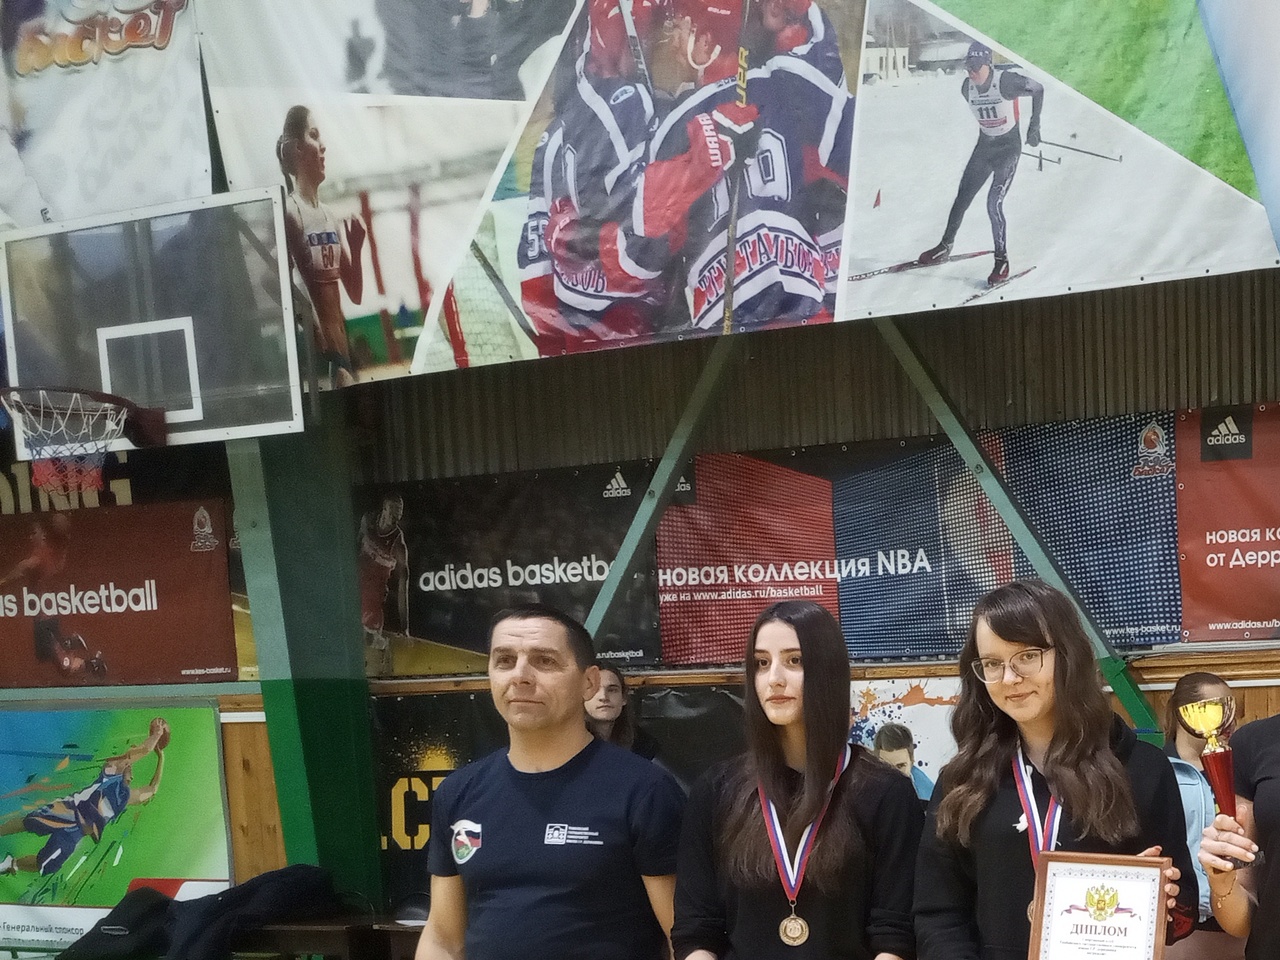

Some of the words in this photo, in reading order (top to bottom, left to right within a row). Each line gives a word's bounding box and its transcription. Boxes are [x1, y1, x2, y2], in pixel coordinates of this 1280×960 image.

[977, 105, 998, 119] 111
[1207, 433, 1246, 445] adidas
[602, 487, 631, 498] adidas
[1206, 528, 1261, 544] новая
[1206, 551, 1226, 567] от
[658, 565, 728, 587] новая
[734, 558, 870, 582] коллекция
[877, 549, 932, 575] NBA
[419, 563, 502, 591] adidas
[22, 579, 158, 616] basketball
[659, 592, 678, 605] уже
[680, 591, 691, 601] на
[693, 585, 823, 601] www.adidas.ru/basketball
[3, 922, 53, 933] Генеральный
[1070, 923, 1128, 937] ДИПЛОМ
